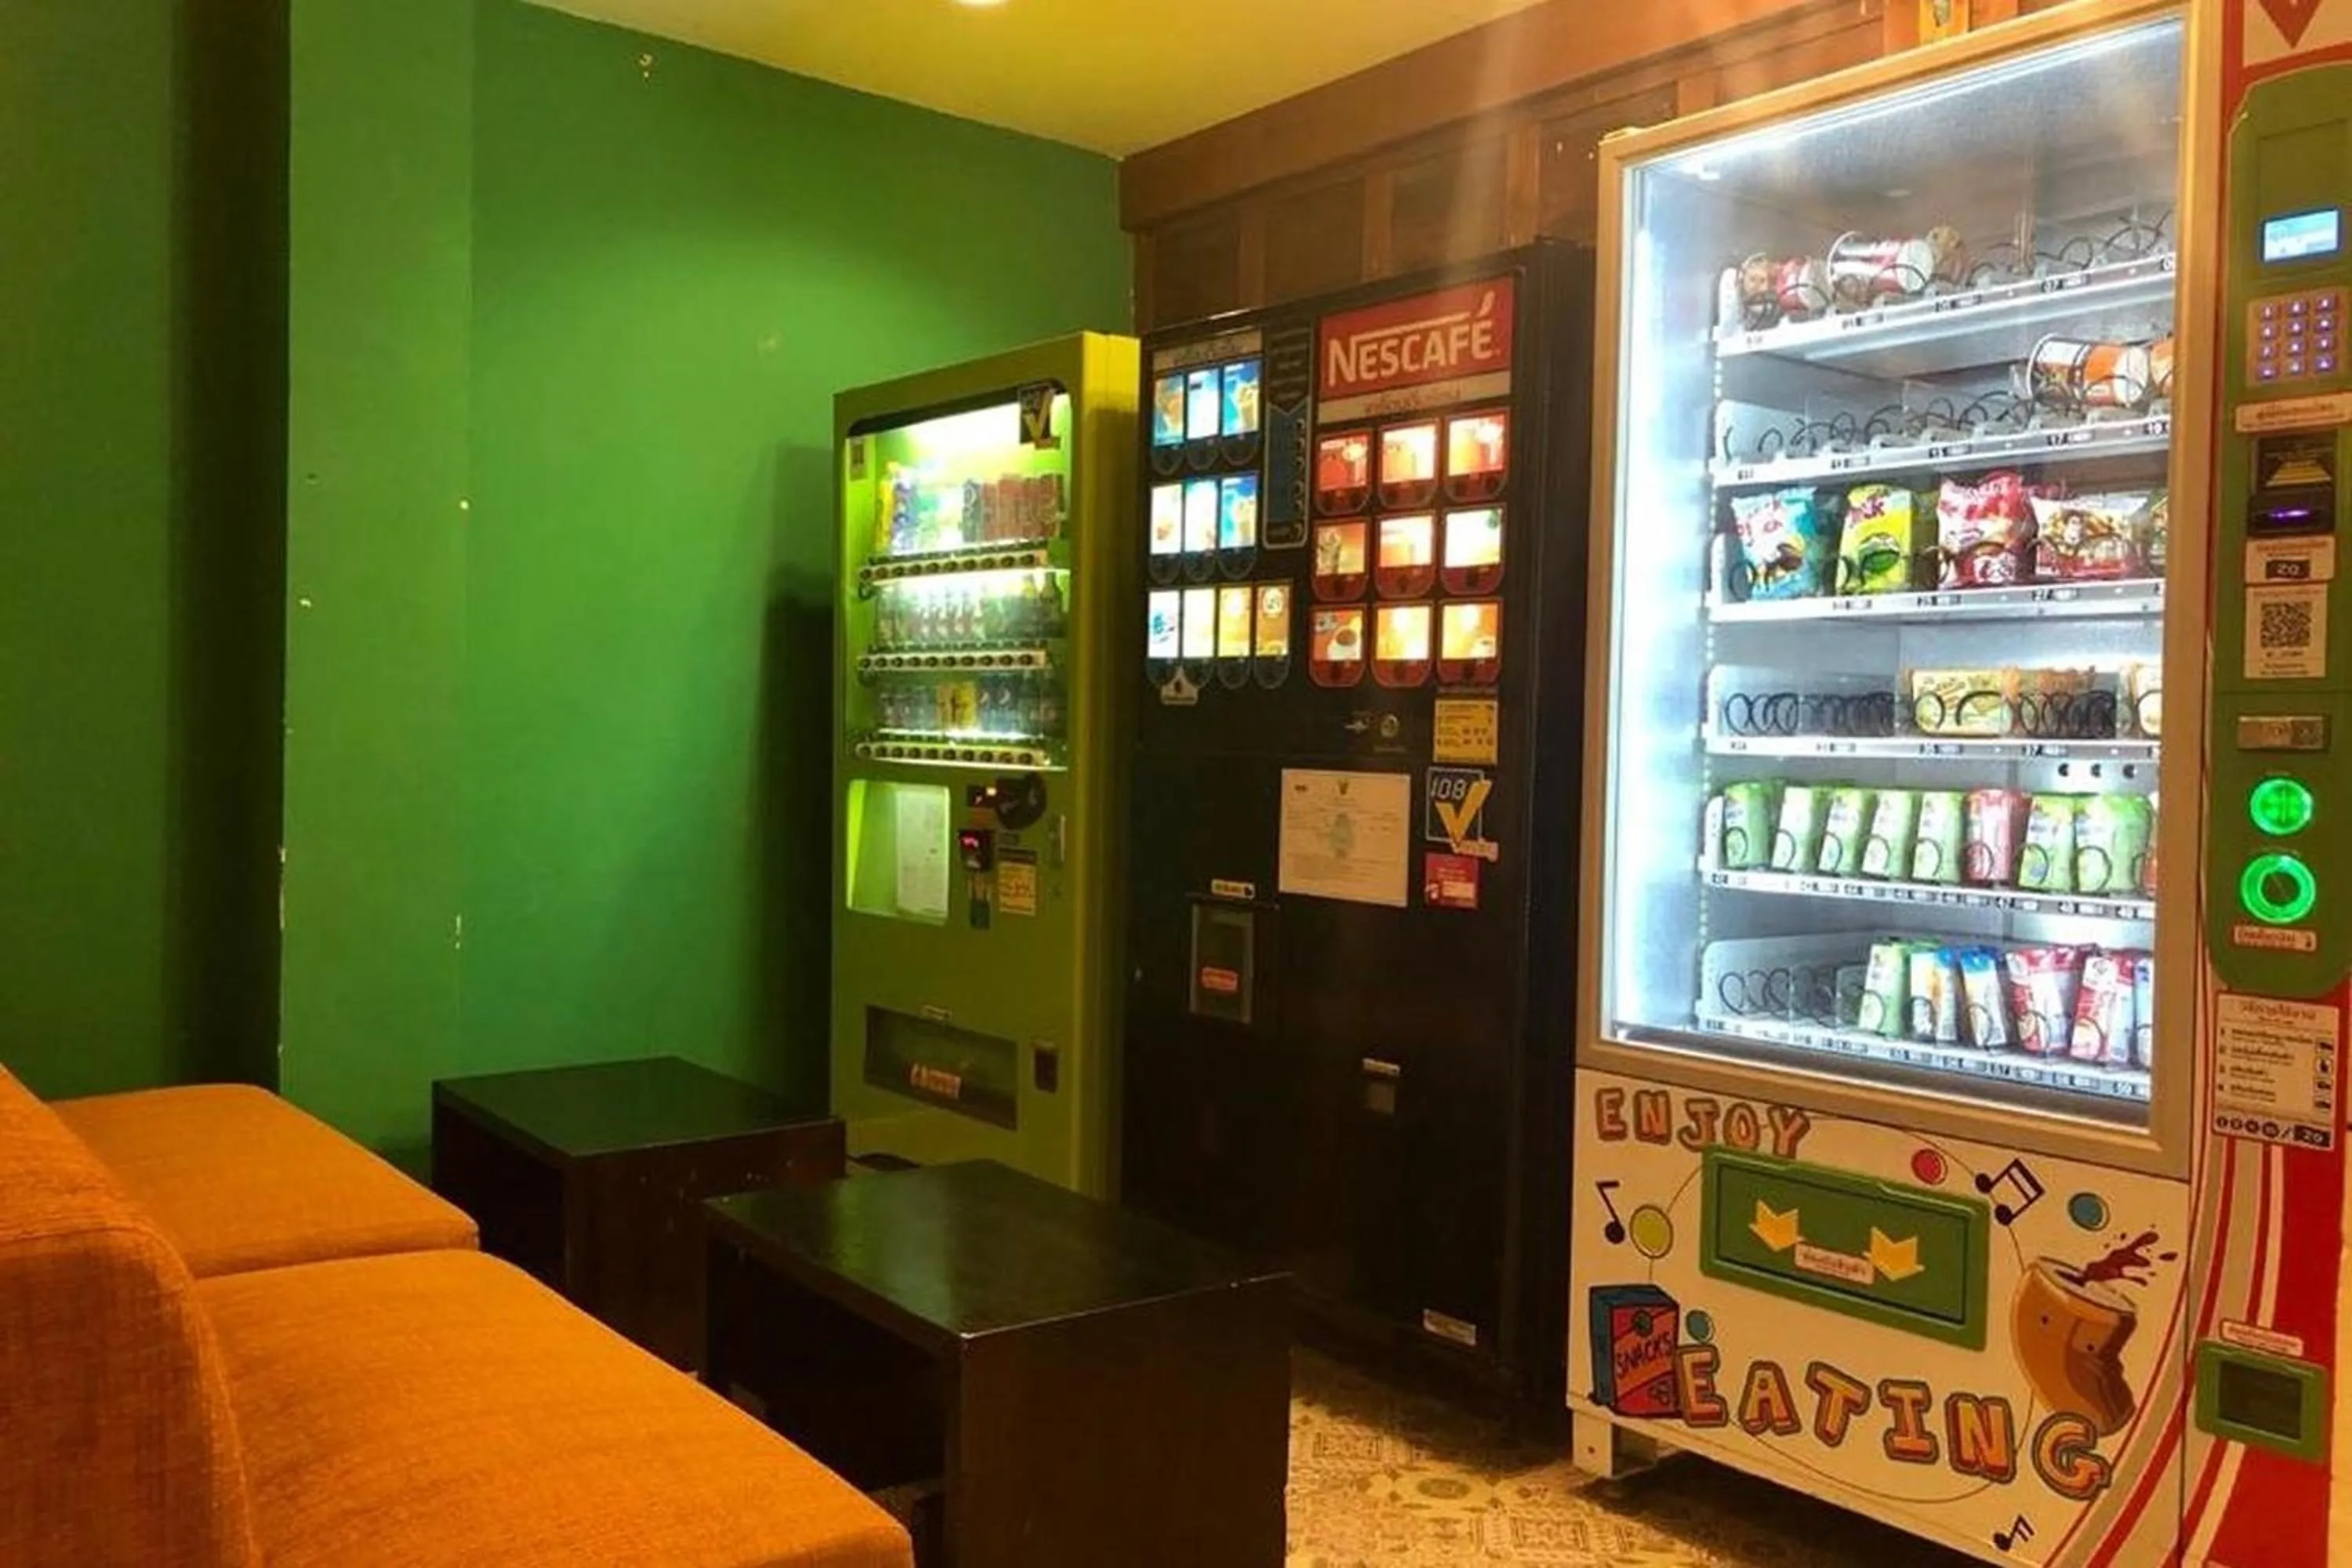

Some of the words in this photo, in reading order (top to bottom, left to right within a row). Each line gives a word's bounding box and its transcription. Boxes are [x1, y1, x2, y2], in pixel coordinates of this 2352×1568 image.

[1328, 290, 1496, 387] NESCAFÉ
[1429, 778, 1468, 800] 108
[1595, 1087, 1811, 1160] ENJOY
[1615, 1331, 1675, 1382] SNACKS
[1676, 1343, 2111, 1501] EATING
